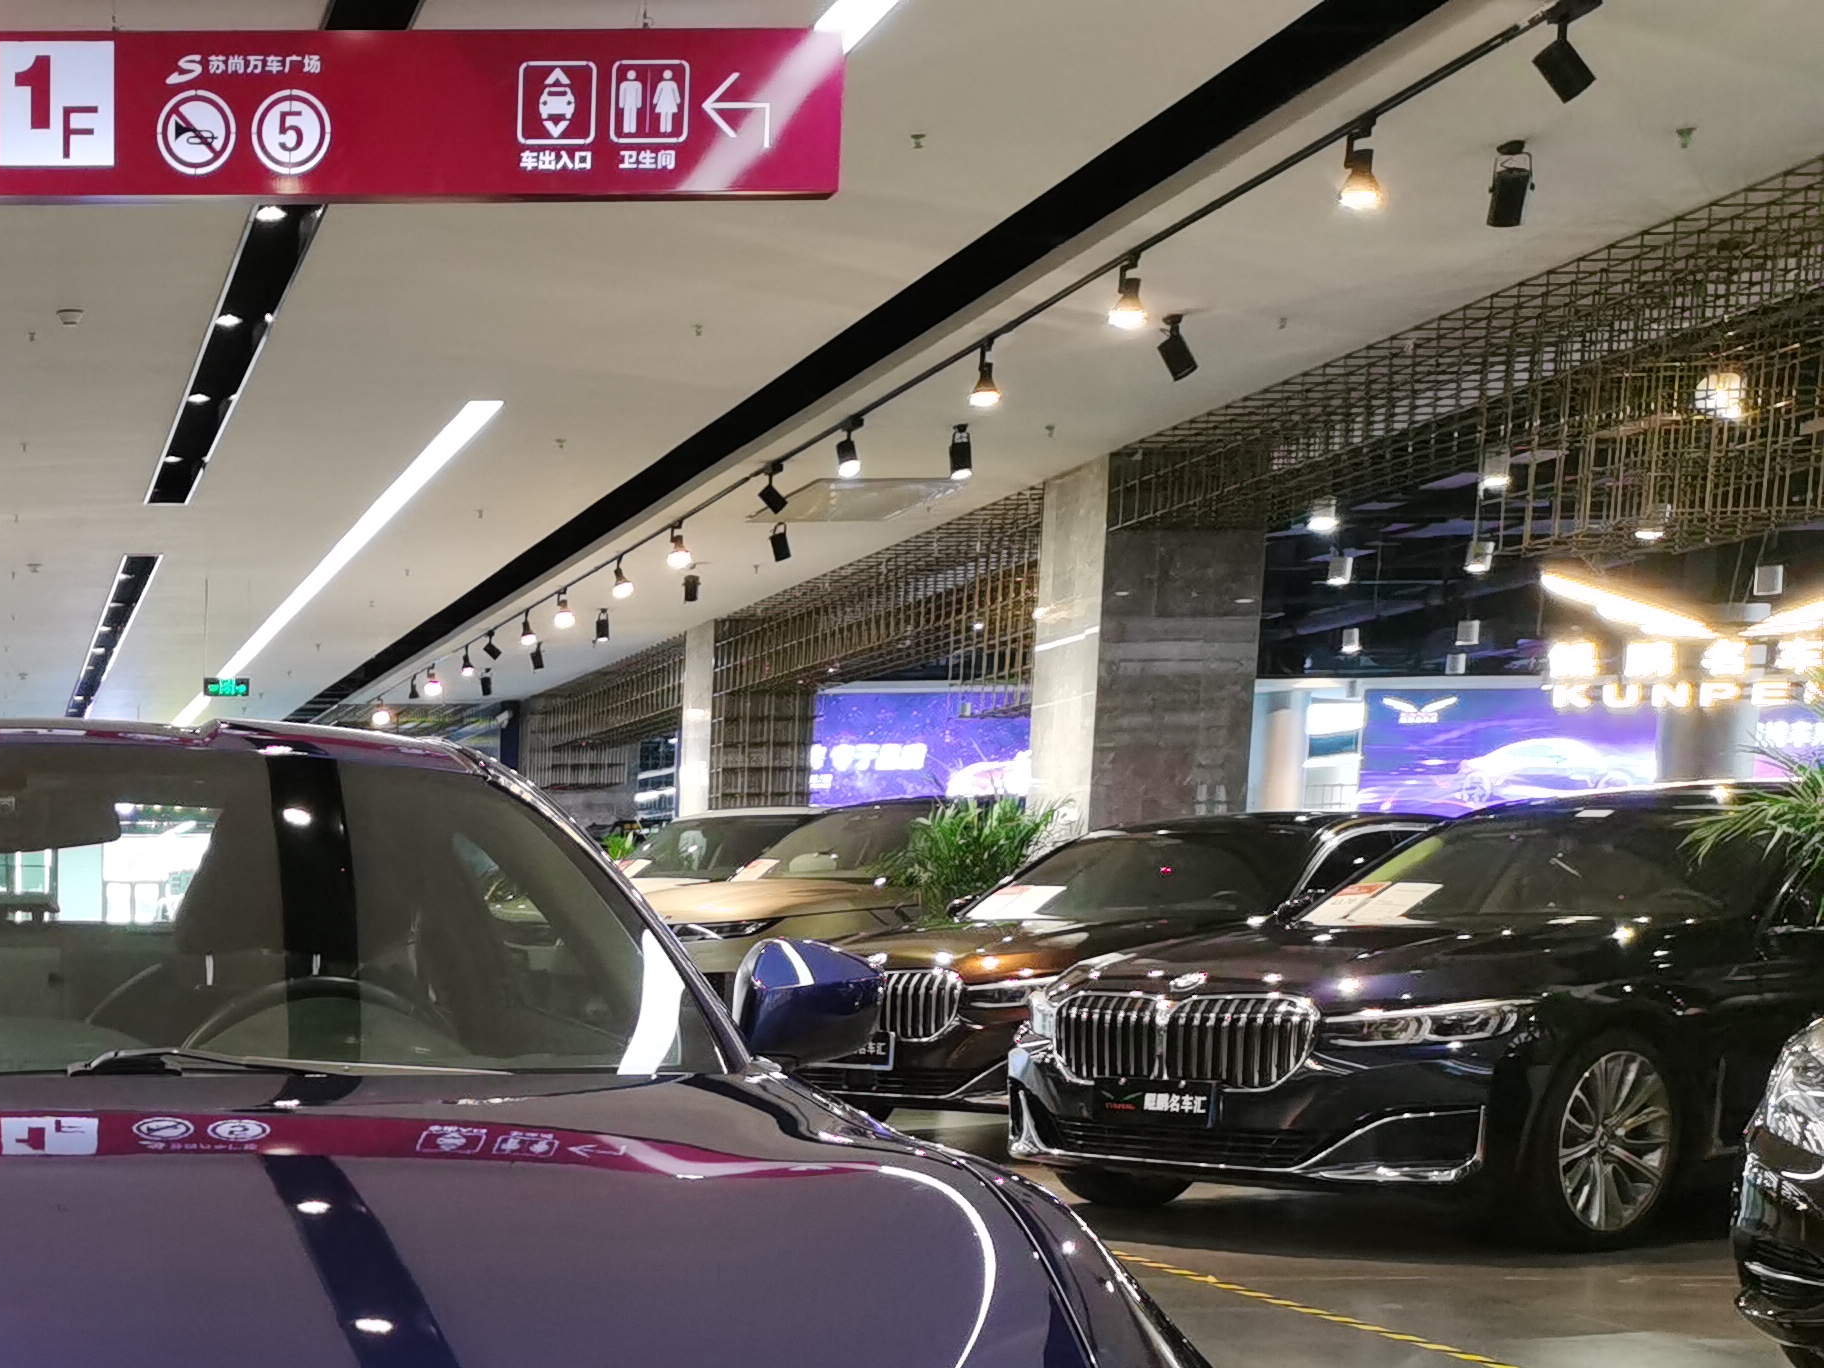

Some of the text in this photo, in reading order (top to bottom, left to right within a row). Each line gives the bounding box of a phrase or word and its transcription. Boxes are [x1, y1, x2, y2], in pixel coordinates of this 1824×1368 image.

[207, 54, 321, 75] 苏尚万车广场
[14, 54, 99, 160] 1F
[277, 110, 304, 152] 5
[519, 150, 676, 171] 车出入口 卫生间
